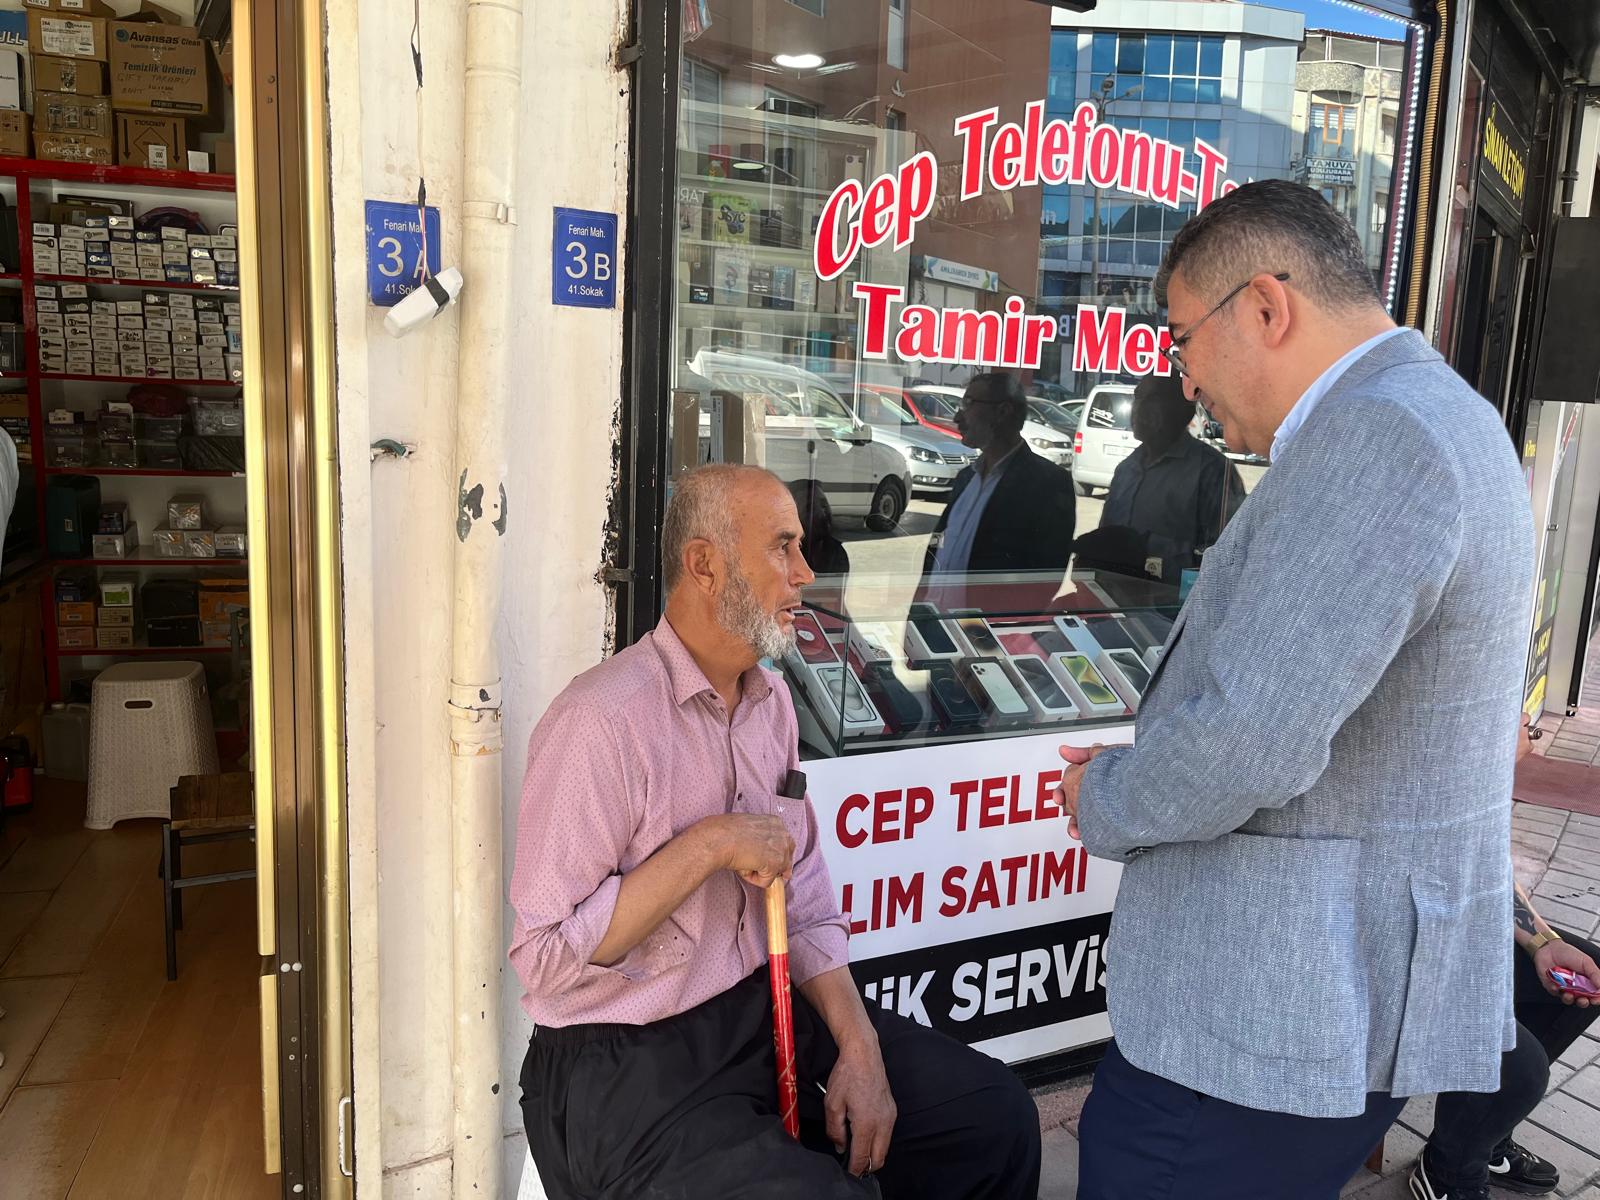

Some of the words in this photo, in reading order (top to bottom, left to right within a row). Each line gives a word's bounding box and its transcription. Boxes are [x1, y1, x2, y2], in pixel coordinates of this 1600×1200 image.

[129, 31, 179, 45] Avansas
[123, 61, 160, 73] Temizlik
[161, 62, 197, 76] Ürünleri
[813, 151, 938, 281] Cep
[953, 99, 1254, 216] Telefonu-T
[383, 218, 407, 232] Fenari
[568, 224, 589, 237] Fenari
[589, 226, 606, 238] Mah.
[377, 237, 404, 277] 3
[413, 249, 432, 279] A
[565, 241, 588, 279] 3
[594, 252, 611, 281] B
[567, 284, 604, 297] 41.Sokak
[852, 281, 1057, 370] Tamir
[1072, 303, 1182, 377] Mer
[835, 786, 934, 849] CEP
[950, 769, 1072, 832] TELE
[938, 846, 1088, 918] SATIMI
